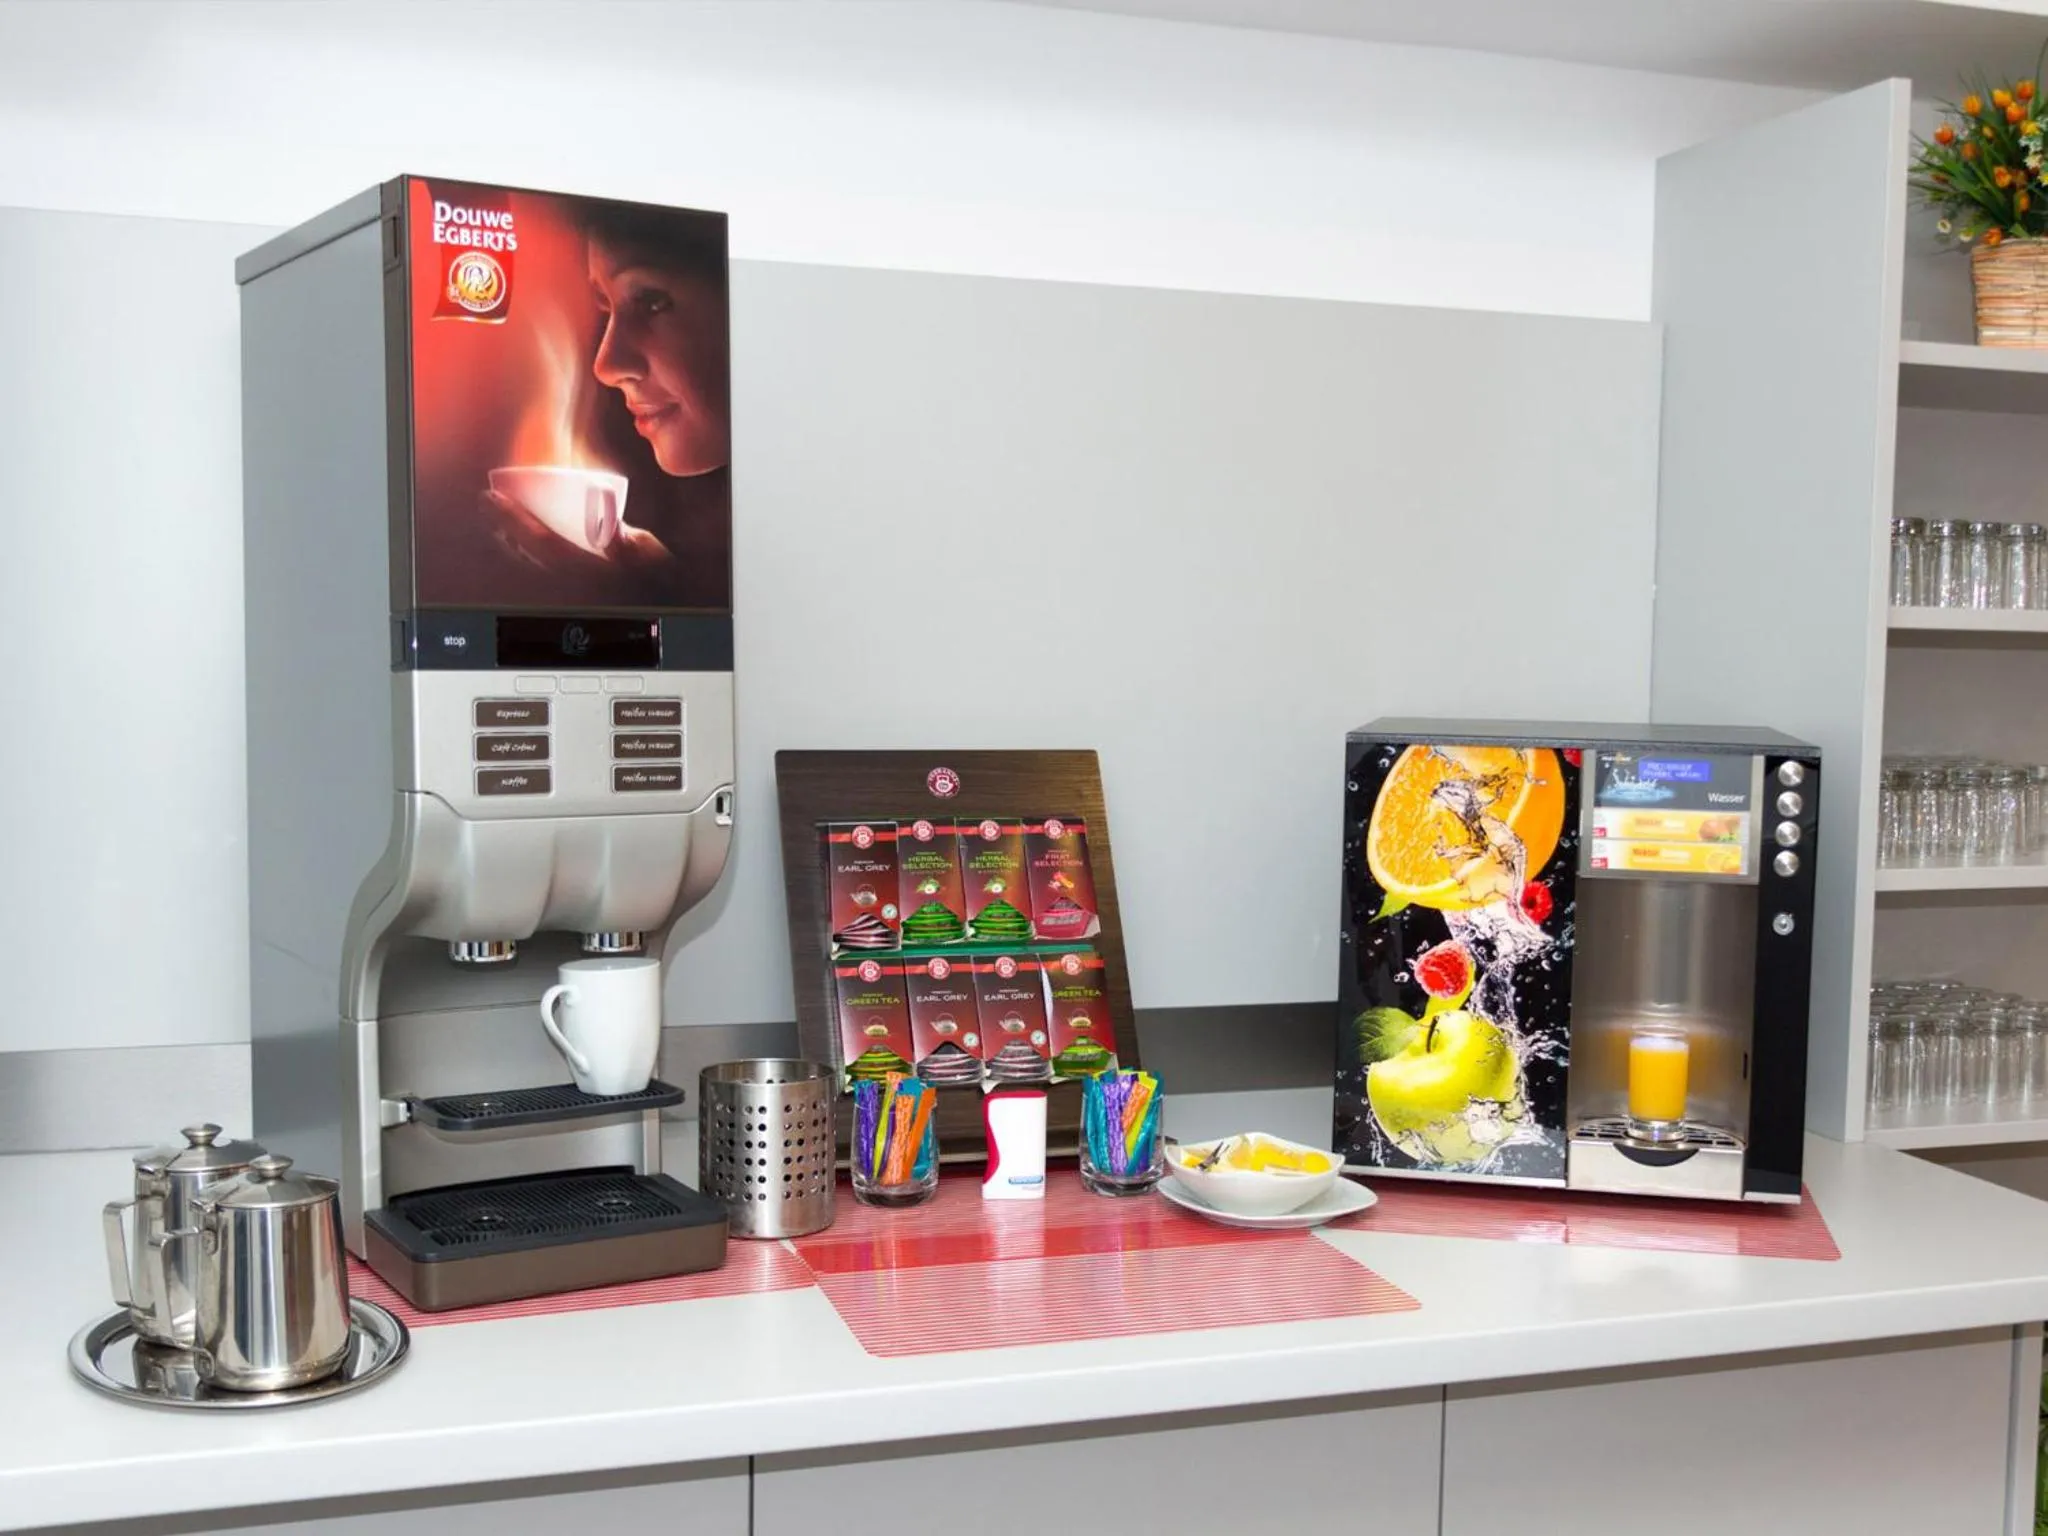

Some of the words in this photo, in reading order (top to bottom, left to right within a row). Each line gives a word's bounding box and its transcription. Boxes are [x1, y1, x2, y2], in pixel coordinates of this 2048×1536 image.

[434, 201, 514, 230] Douwe
[433, 223, 518, 252] EGBERTS
[444, 635, 466, 648] stop
[1708, 792, 1746, 804] Wasser
[837, 864, 864, 873] EARL
[865, 863, 891, 872] GREY
[916, 995, 941, 1003] EARL
[943, 993, 969, 1002] GREY
[984, 994, 1009, 1002] EARL
[1010, 992, 1036, 1000] GREY
